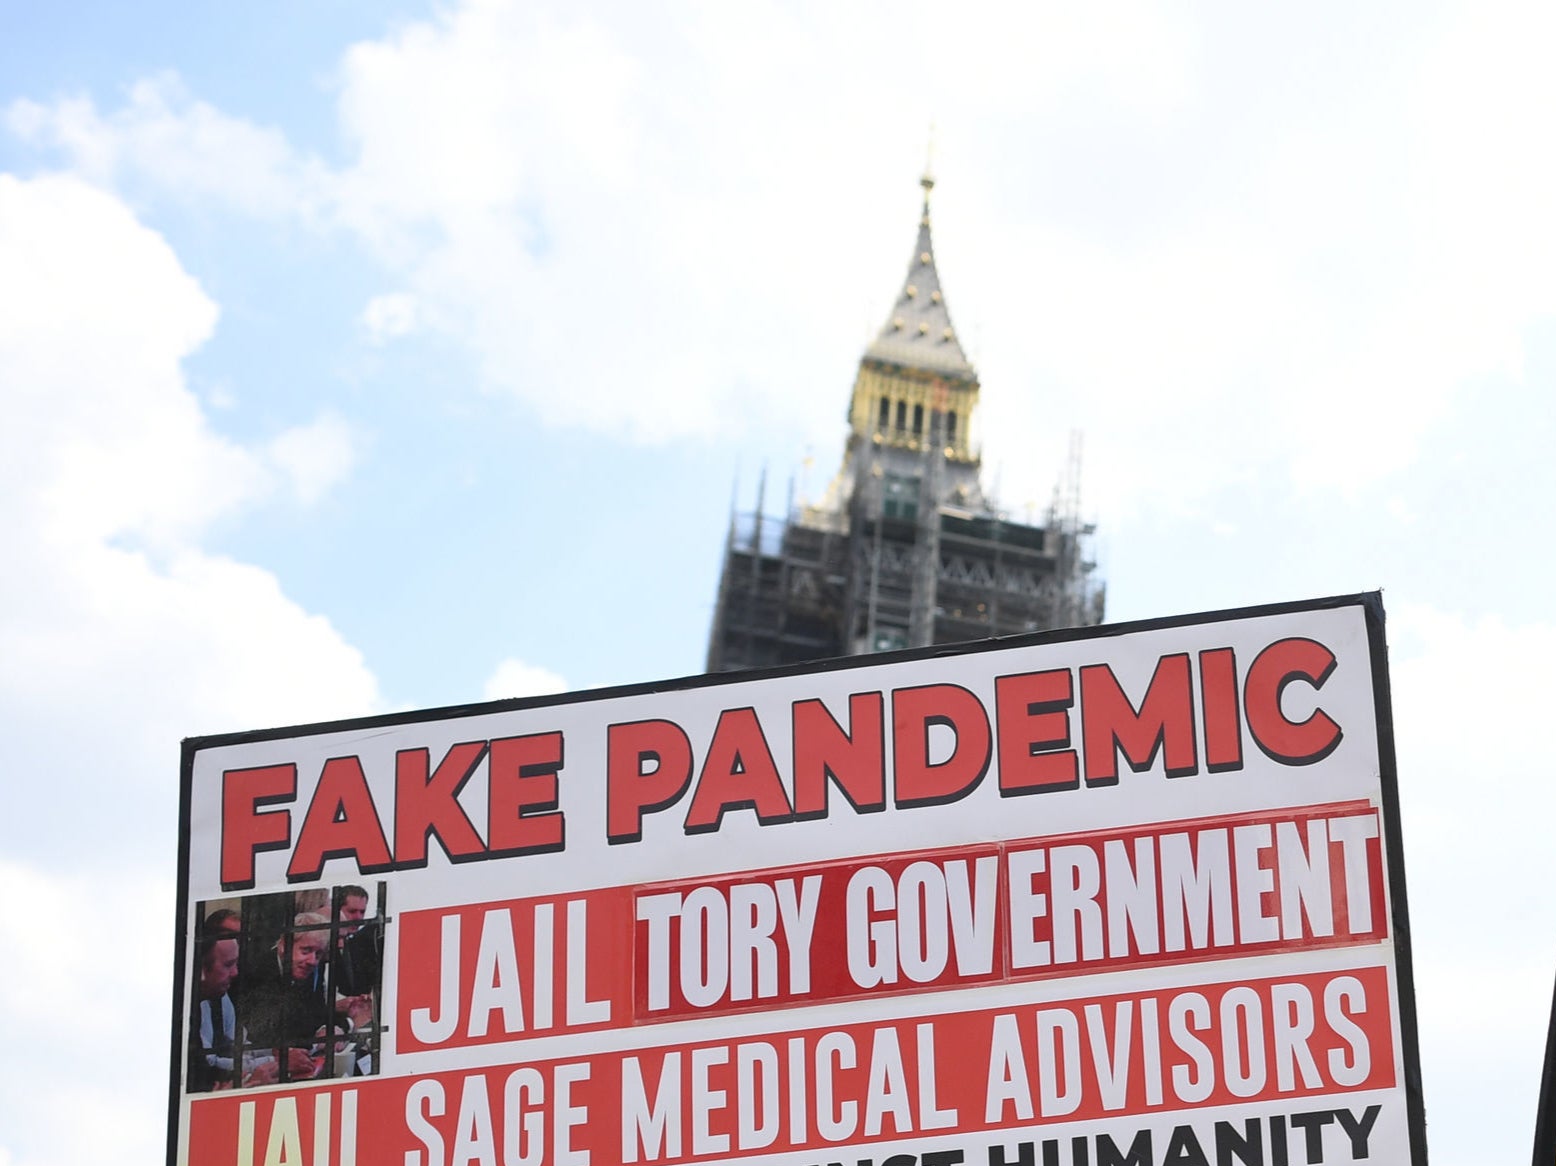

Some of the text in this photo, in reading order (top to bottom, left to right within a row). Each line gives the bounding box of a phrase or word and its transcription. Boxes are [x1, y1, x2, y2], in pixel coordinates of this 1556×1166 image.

[221, 637, 1343, 892] FAKE PANDEMIC
[410, 815, 1380, 1044] JAIL TORY GOVERNMENT
[622, 1024, 958, 1163] MEDICAL
[985, 977, 1371, 1123] ADVISORS
